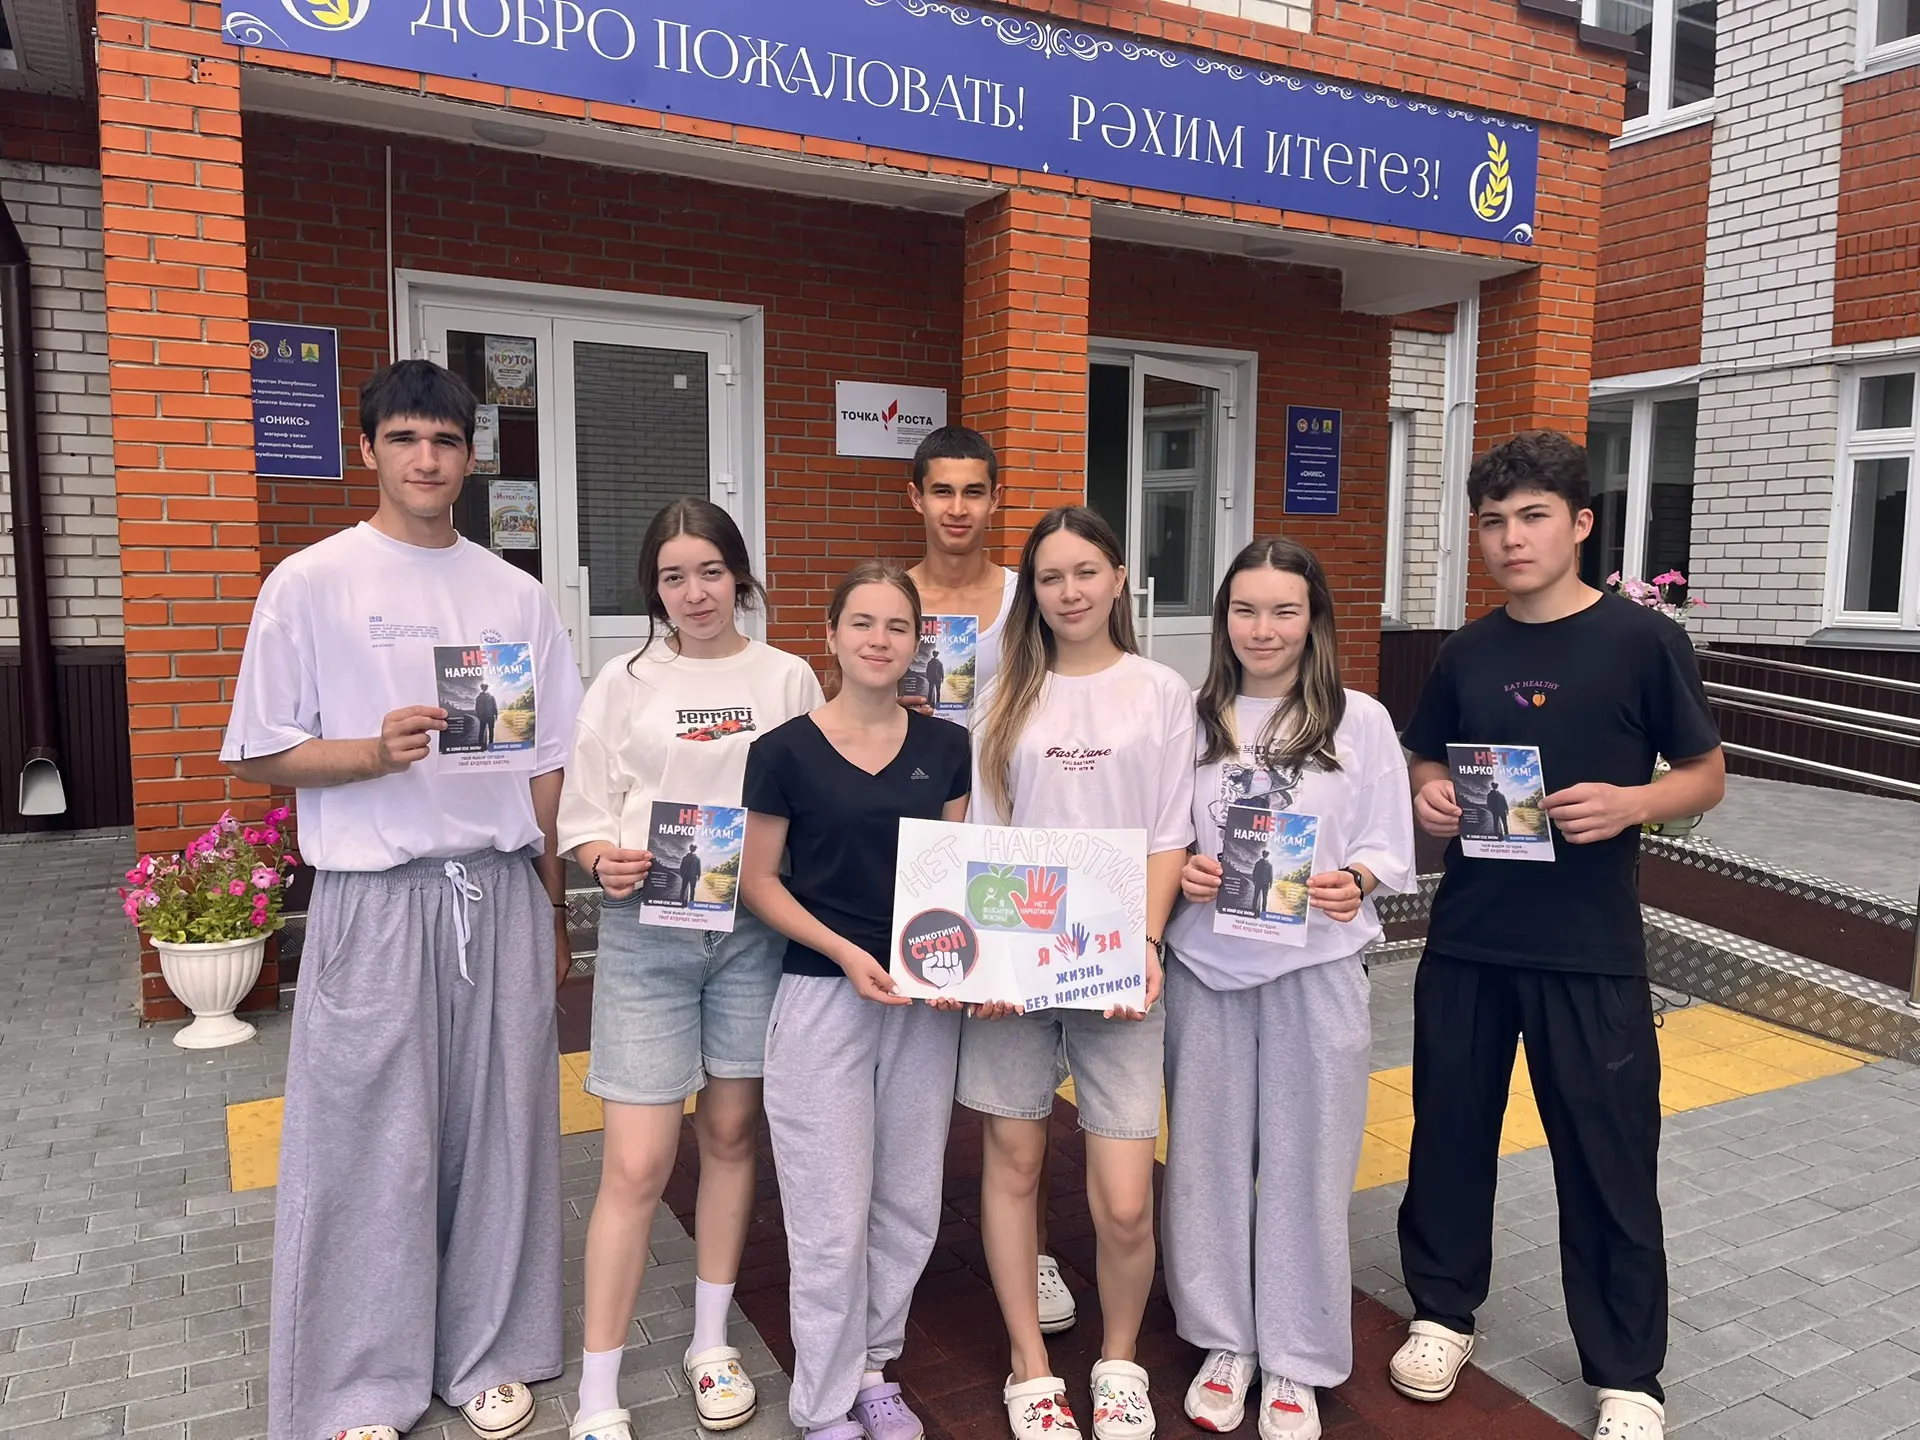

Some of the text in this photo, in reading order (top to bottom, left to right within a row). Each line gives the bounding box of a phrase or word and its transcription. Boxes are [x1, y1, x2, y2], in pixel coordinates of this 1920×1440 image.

[410, 0, 1025, 132] ДОБРО ПОЖАЛОВАТЬ!
[1068, 94, 1246, 169] РӘХИМ
[260, 415, 310, 426] «ОНИКС»
[841, 411, 933, 425] ТОЧКА РОСТА
[921, 621, 952, 635] НЕТ
[462, 649, 500, 667] НЕТ
[445, 664, 523, 678] НАРКОТИКАМ!
[1503, 680, 1560, 692] EAT HEALTHY
[675, 707, 753, 724] Ferrari
[1044, 746, 1079, 758] Fast
[1474, 751, 1510, 766] НЕТ
[679, 808, 717, 826] НЕТ
[1252, 814, 1288, 833] НЕТ
[899, 835, 962, 898] НЕТ
[908, 925, 962, 946] НАРКОТИКИ
[911, 931, 967, 960] СТОП
[1037, 930, 1122, 967] Я ЗА
[1056, 964, 1104, 985] ЖИЗНЬ
[1026, 974, 1142, 1011] БЕЗ НАРКОТИКОВ
